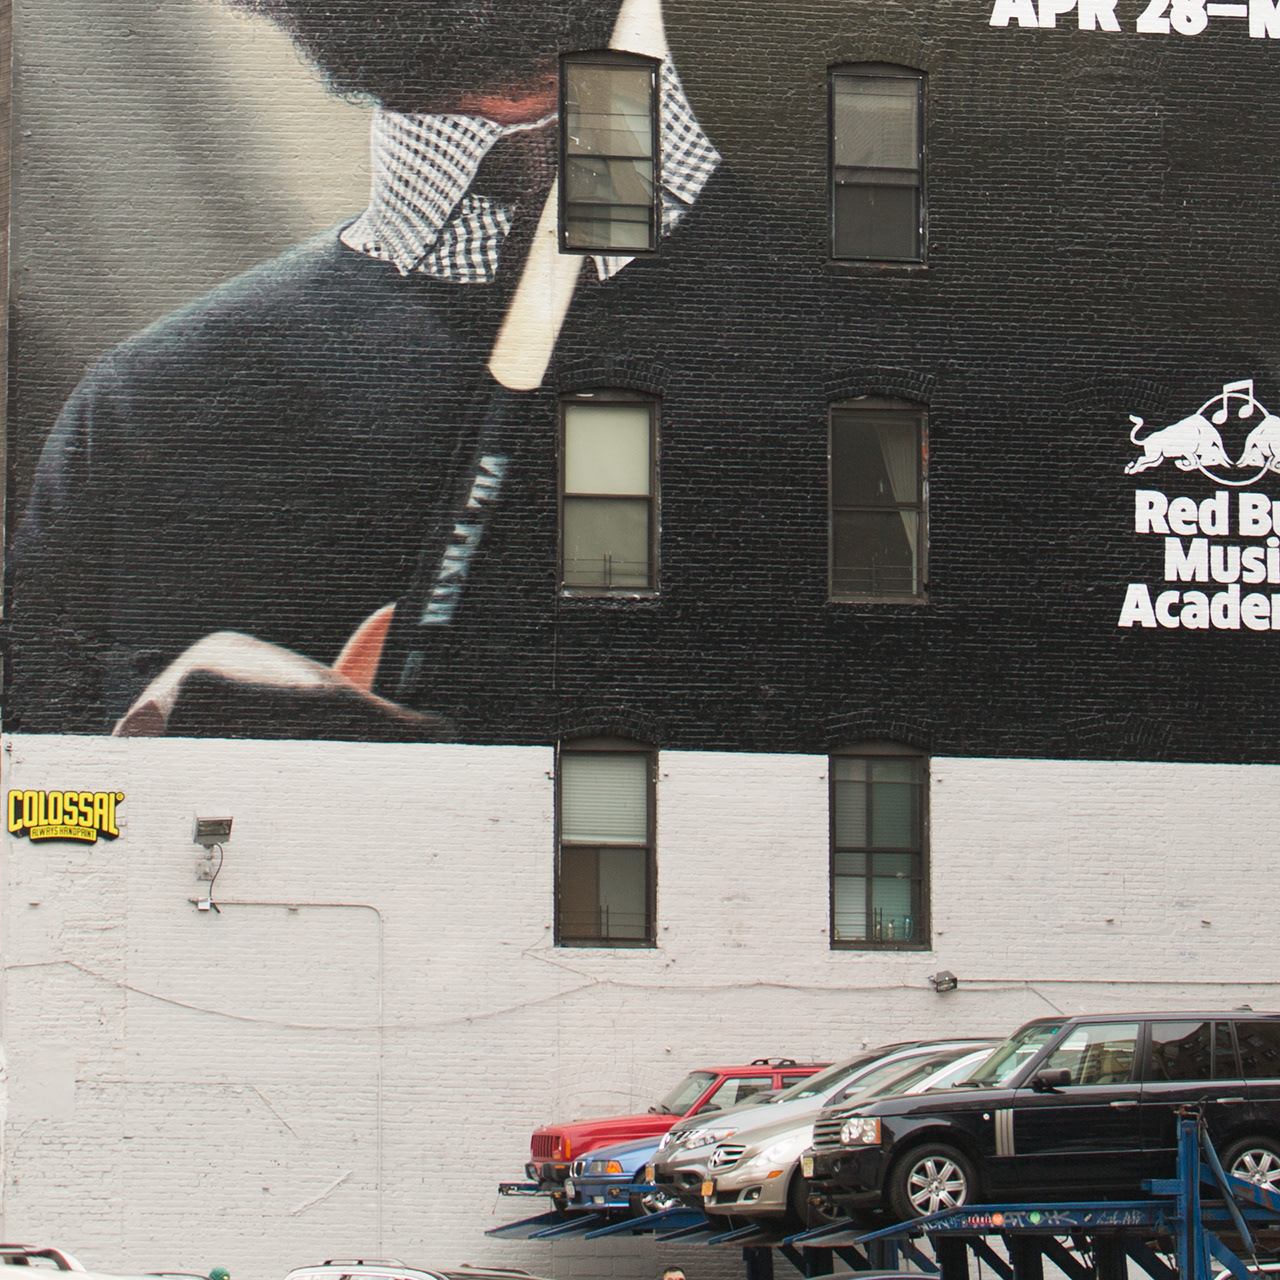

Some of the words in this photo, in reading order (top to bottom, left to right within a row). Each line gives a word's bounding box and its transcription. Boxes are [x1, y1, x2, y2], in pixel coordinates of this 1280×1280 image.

[1134, 490, 1230, 536] Red
[8, 790, 120, 837] COLOSSAL
[32, 827, 58, 838] ALWAYS
